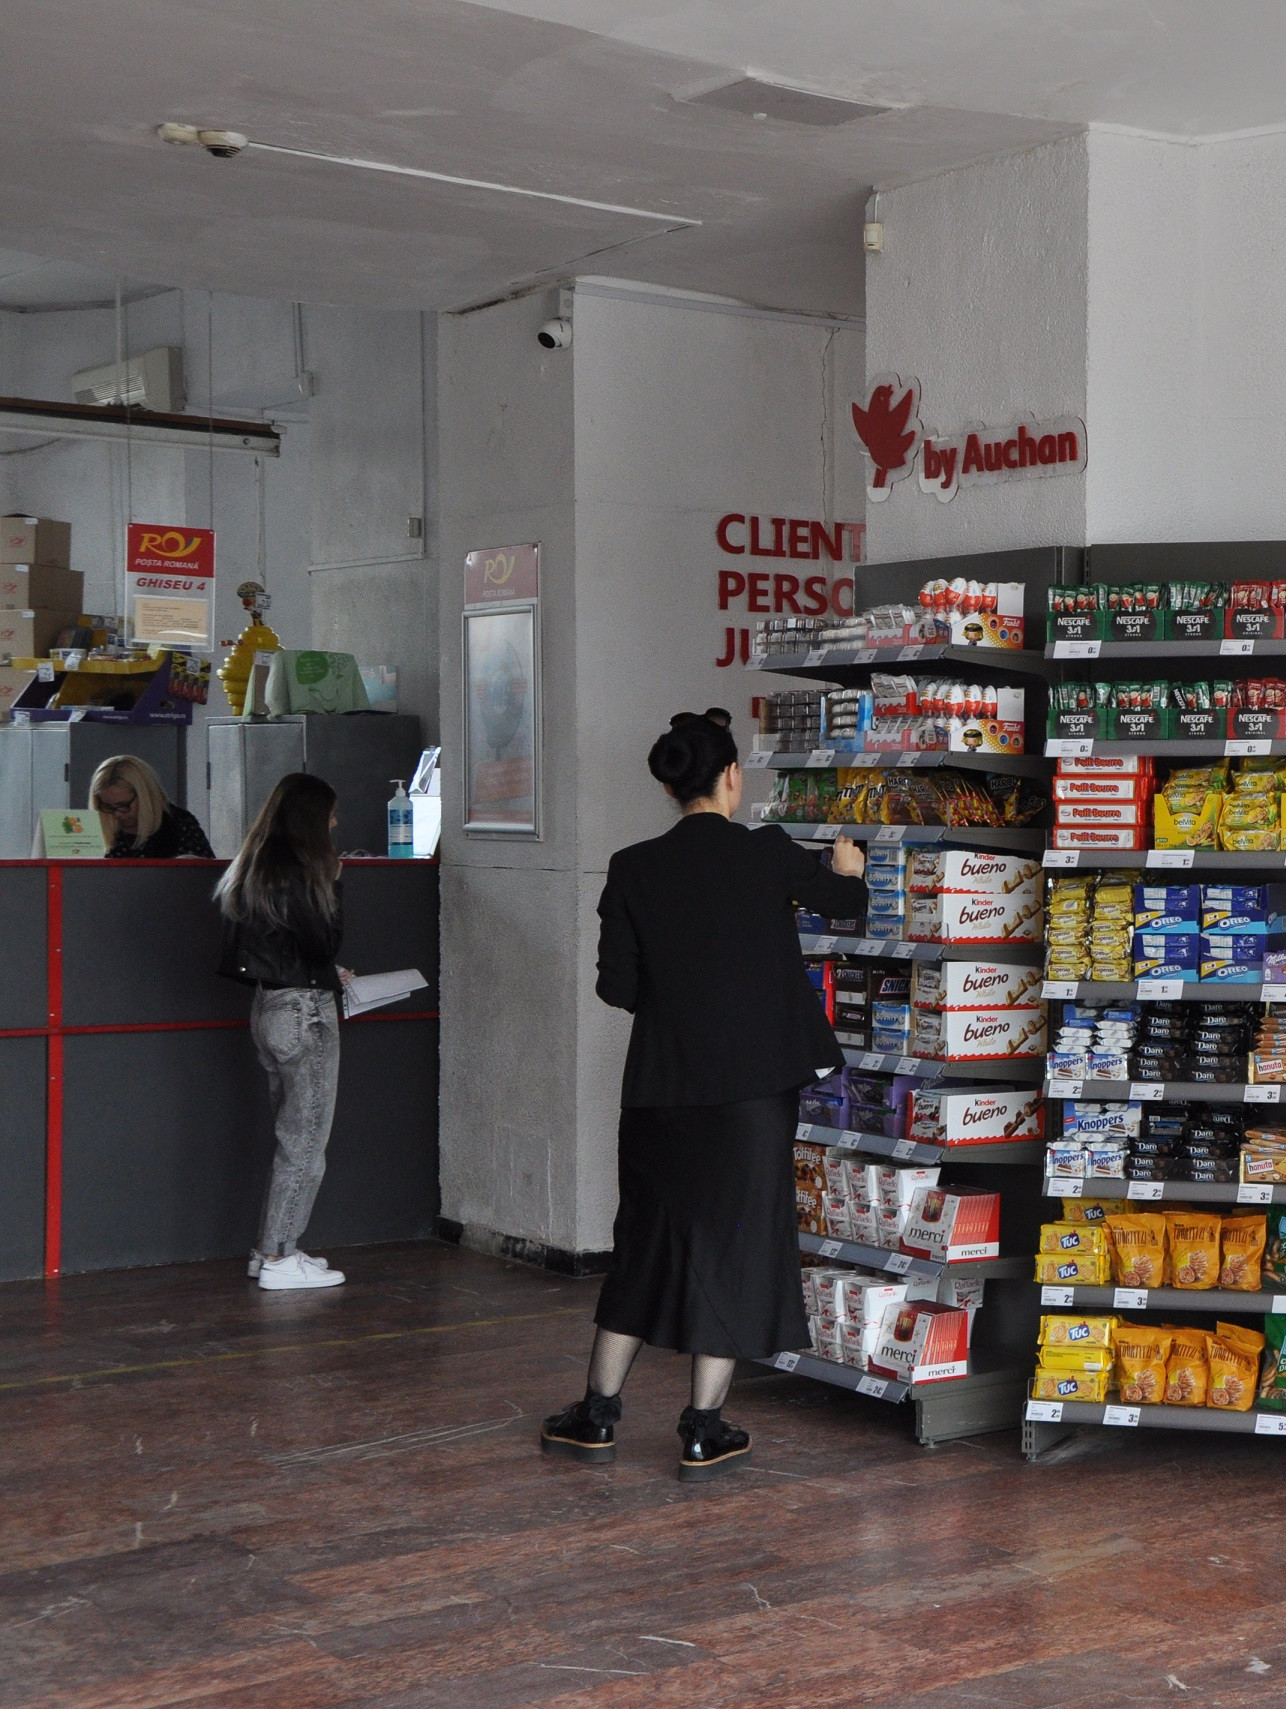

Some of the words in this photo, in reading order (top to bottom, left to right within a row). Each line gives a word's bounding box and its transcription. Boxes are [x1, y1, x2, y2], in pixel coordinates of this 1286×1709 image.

[924, 438, 958, 489] by
[961, 426, 1078, 475] Auchan
[196, 582, 206, 591] 4
[960, 859, 1007, 876] bueno
[959, 906, 1006, 925] bueno
[1151, 916, 1182, 928] OREO
[1219, 916, 1251, 928] OREO
[1151, 965, 1183, 976] OREO
[1217, 965, 1249, 976] OREO
[963, 974, 1009, 993] bueno
[964, 1023, 1010, 1042] bueno
[1258, 1062, 1282, 1073] hanuta
[962, 1105, 1008, 1126] bueno
[1077, 1113, 1124, 1132] Knoppers
[1053, 1152, 1084, 1164] noppers
[1249, 1161, 1273, 1172] hanuta
[1085, 1208, 1103, 1220] TUC
[908, 1226, 946, 1244] merci
[1061, 1236, 1079, 1249] TUC
[961, 1246, 988, 1257] merci
[1058, 1265, 1077, 1278] TUC
[1069, 1326, 1088, 1340] TUC
[881, 1344, 917, 1363] merci
[928, 1366, 957, 1377] merci
[1058, 1381, 1077, 1394] TUC
